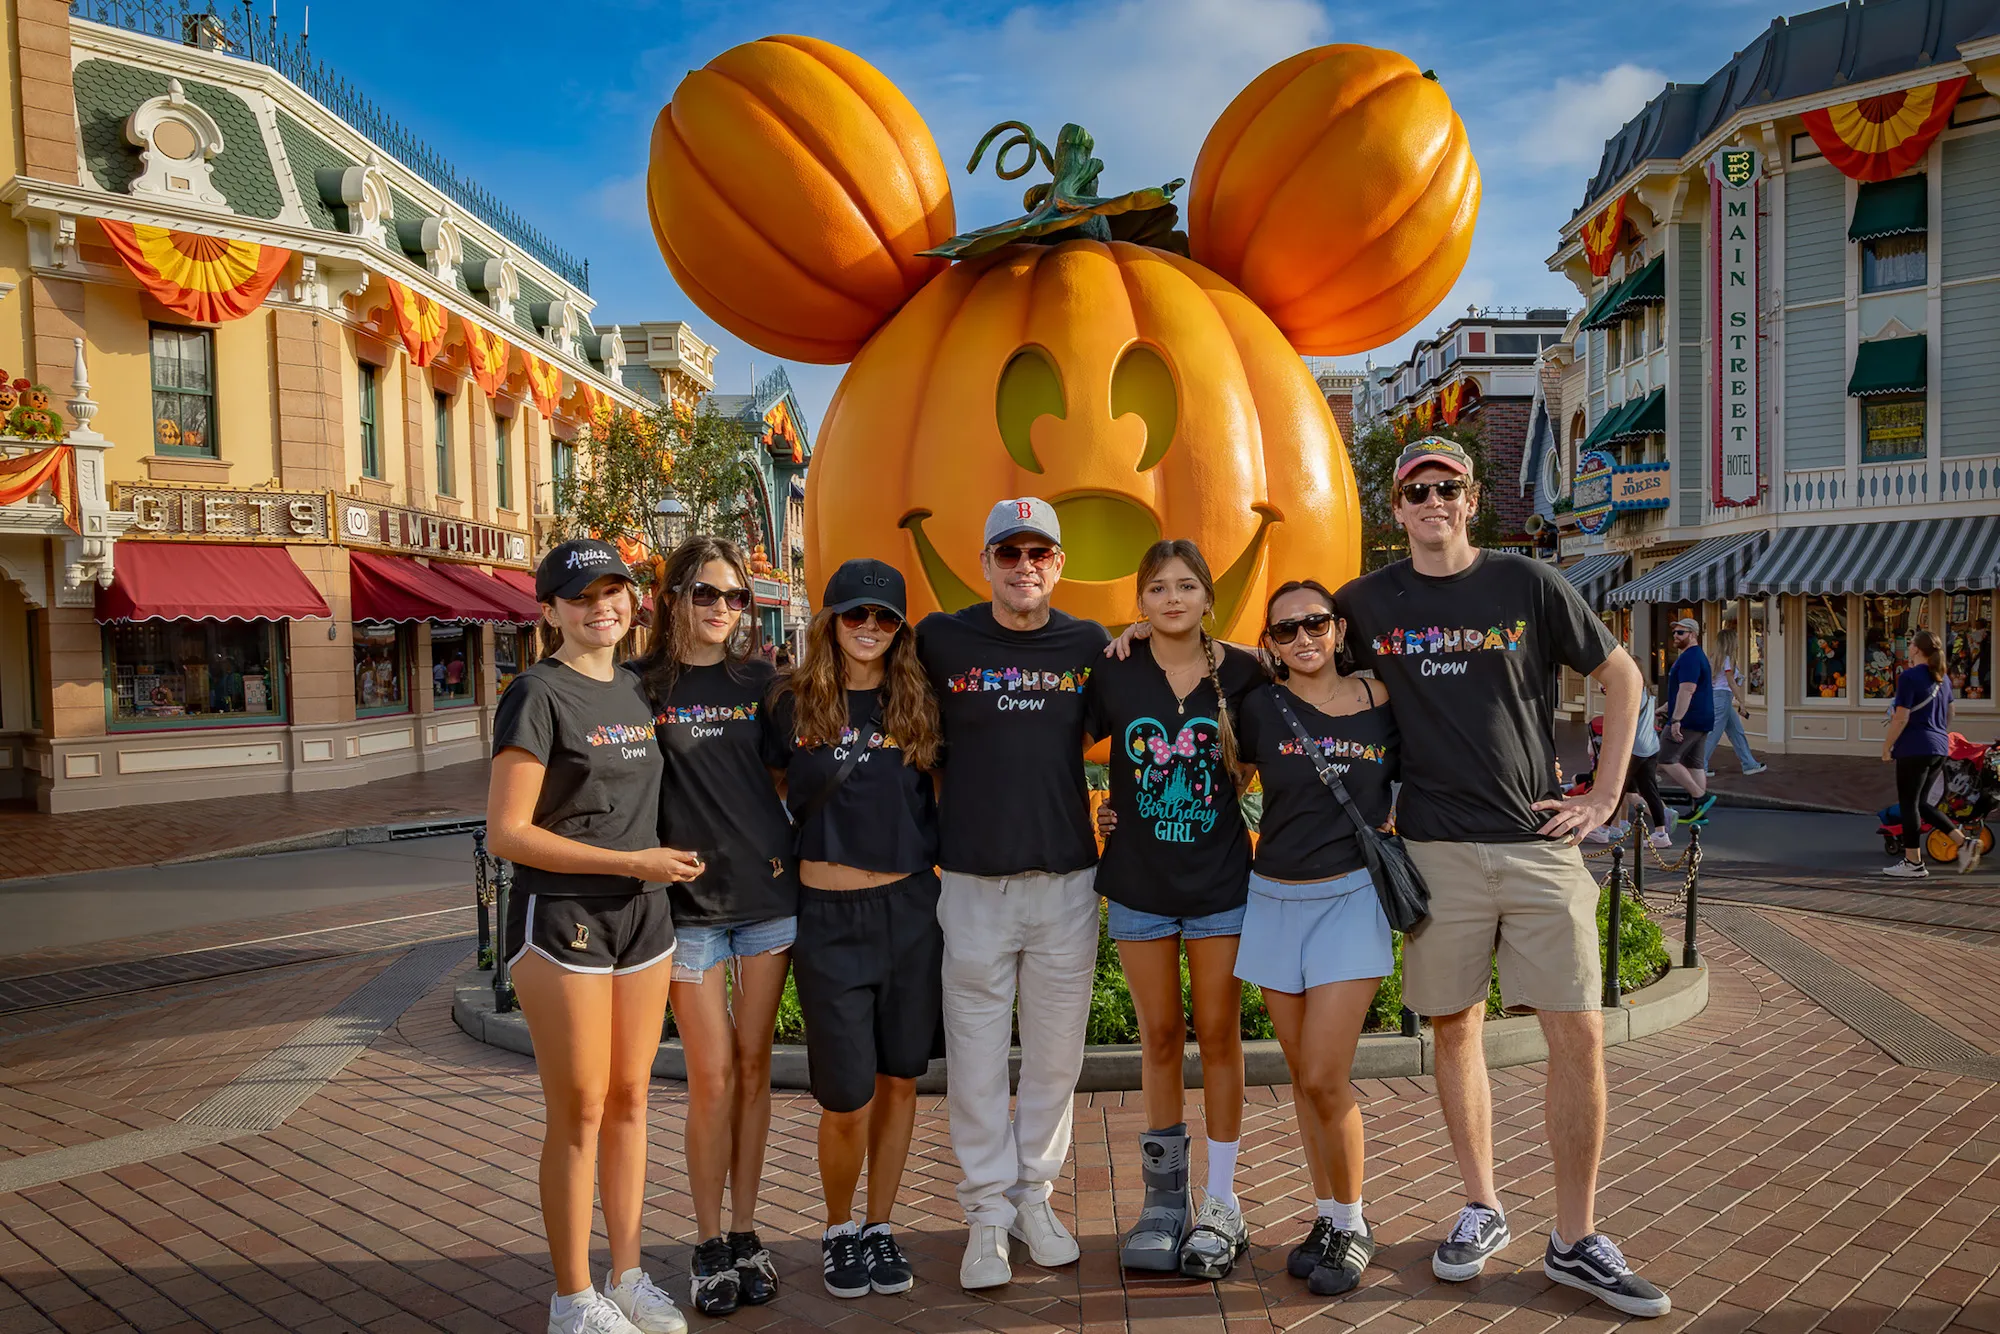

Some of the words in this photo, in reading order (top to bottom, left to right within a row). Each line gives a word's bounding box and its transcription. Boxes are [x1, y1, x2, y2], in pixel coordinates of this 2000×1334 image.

[1728, 201, 1747, 287] MAIN
[1730, 311, 1748, 442] STREET
[1727, 454, 1754, 476] HOTEL
[1620, 477, 1661, 496] JOKES
[133, 493, 322, 535] GIFTS
[1015, 501, 1032, 519] B
[349, 511, 368, 532] 101
[380, 510, 514, 562] EMPORIUM
[863, 572, 887, 587] alo
[1372, 620, 1526, 656] BIRTHDAY
[1420, 658, 1468, 677] Crew
[948, 666, 1092, 694] BIRTHDAY
[997, 694, 1046, 711] Crew
[691, 725, 724, 738] Crew
[621, 746, 646, 760] Crew
[833, 746, 871, 763] Crw
[1278, 736, 1387, 765] BITHDAY
[1135, 791, 1219, 833] Birthday
[1154, 820, 1196, 843] GIRL
